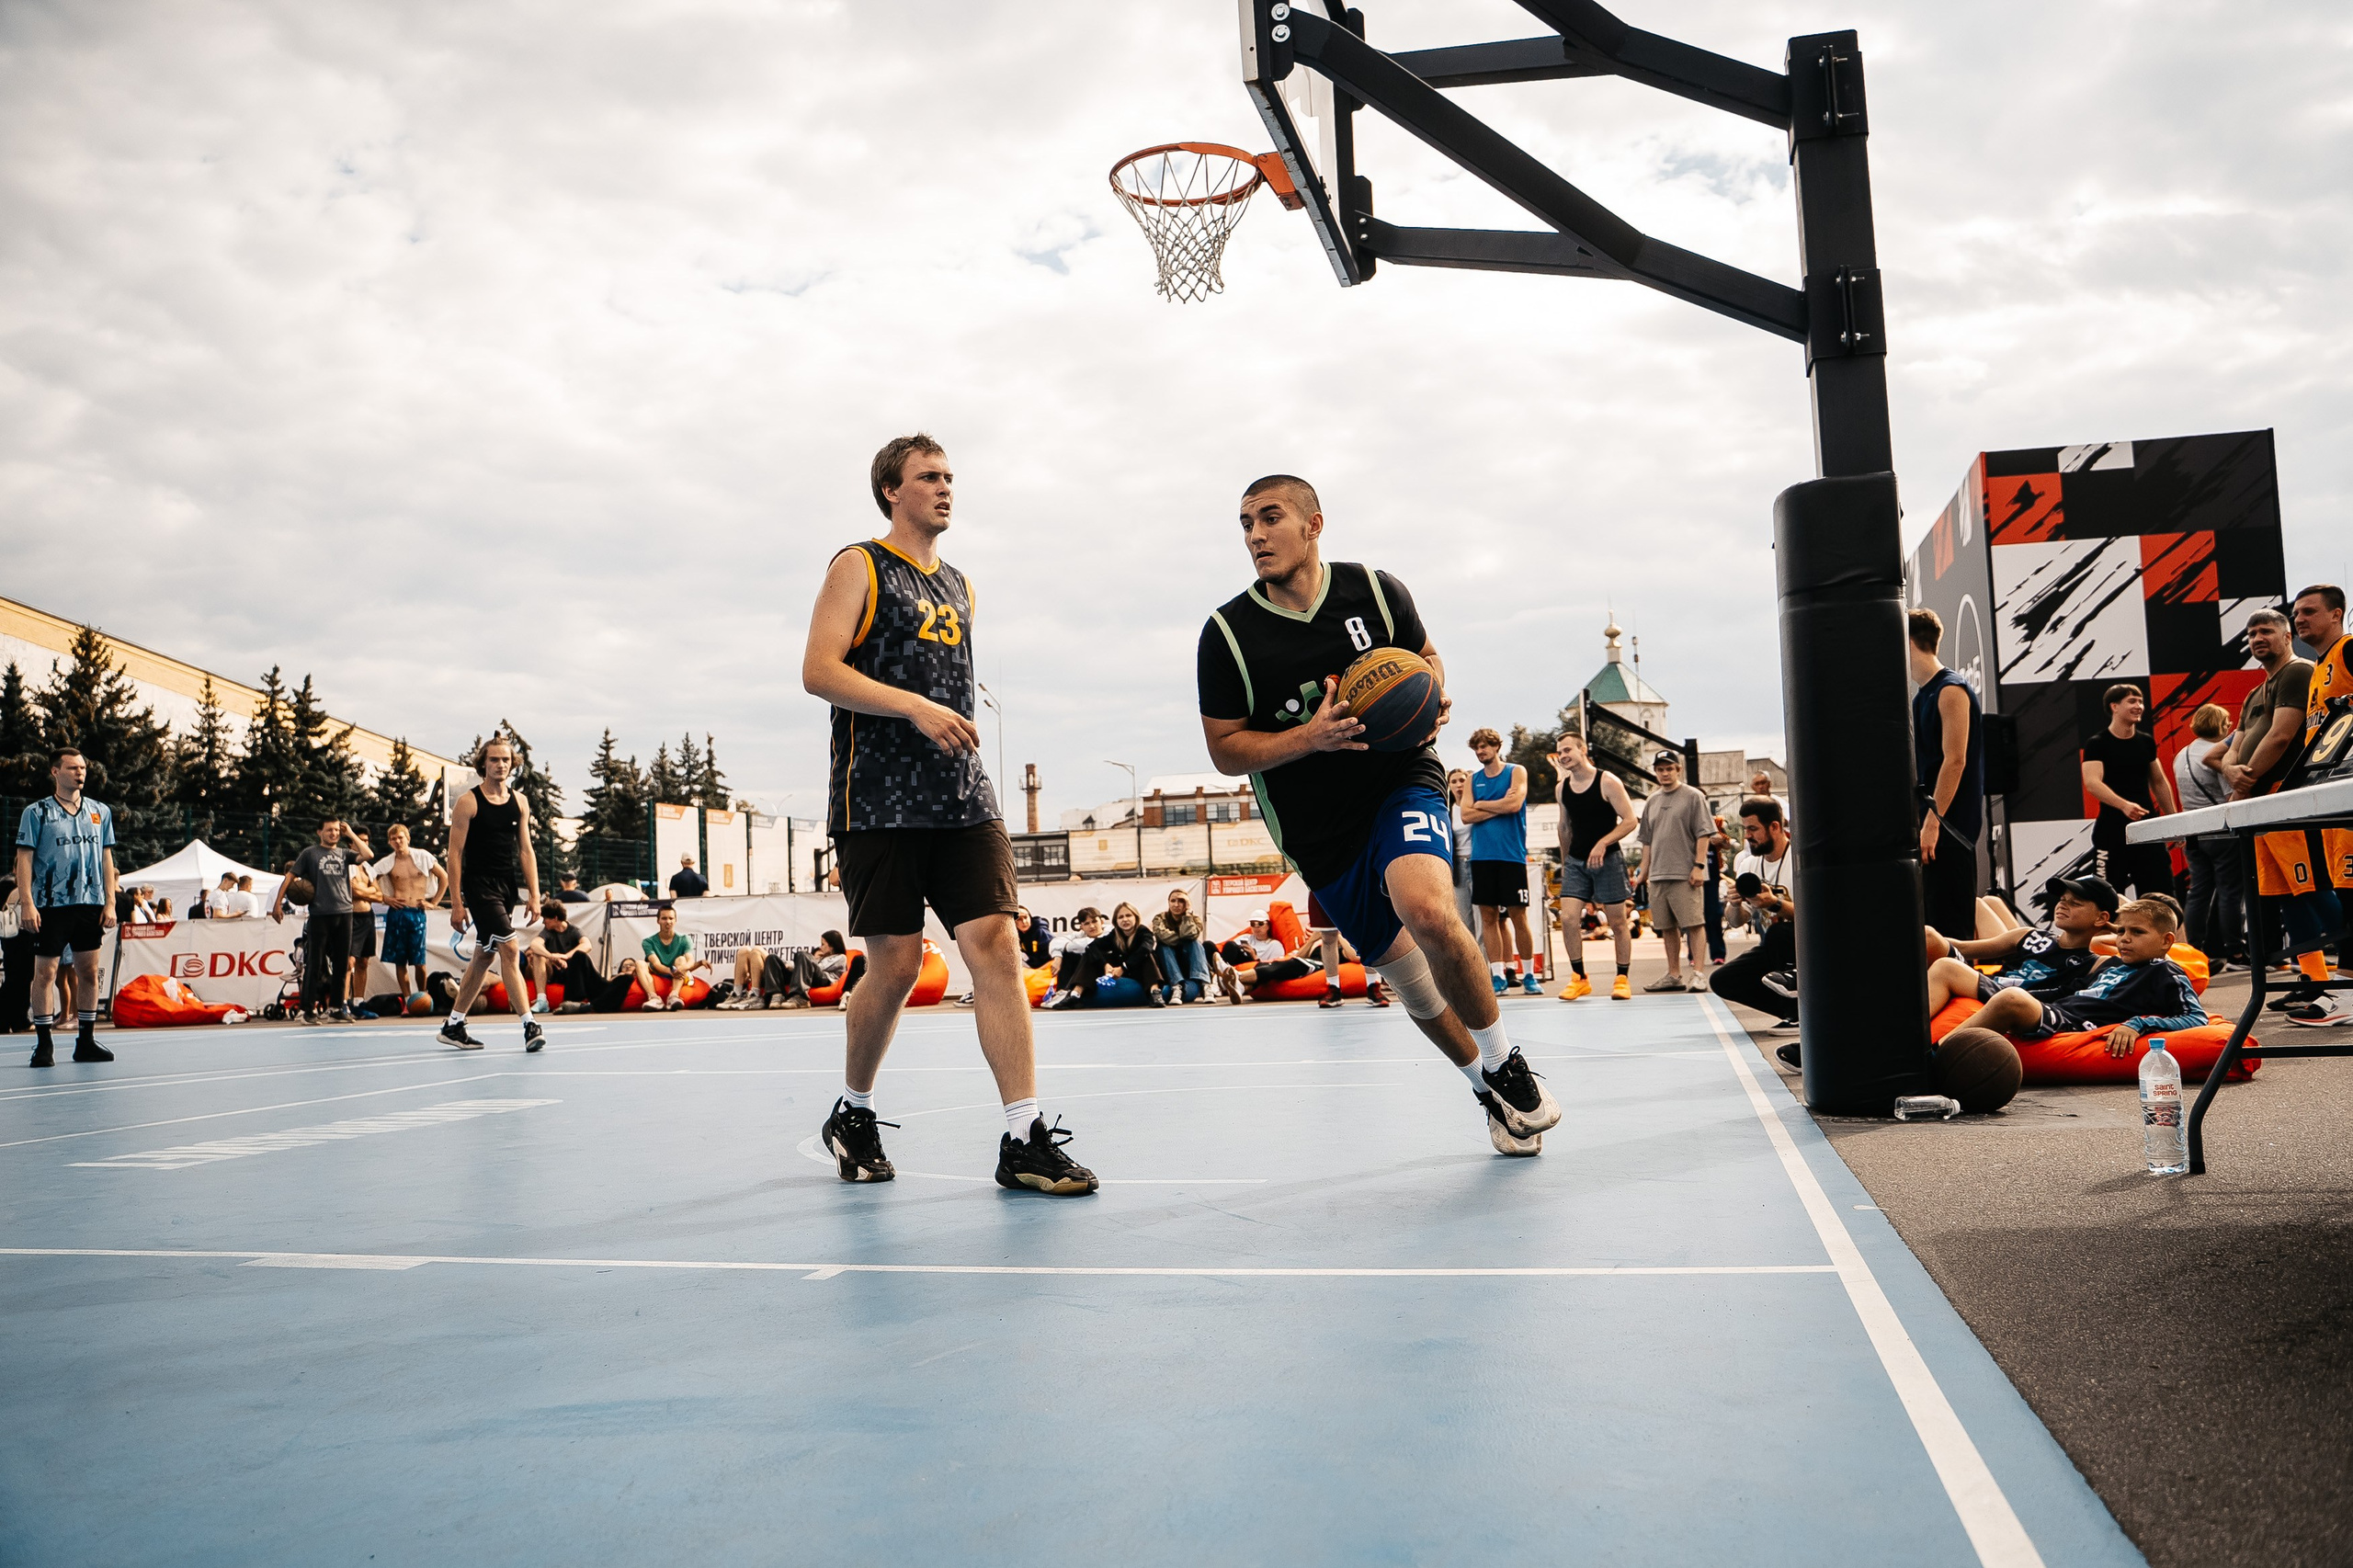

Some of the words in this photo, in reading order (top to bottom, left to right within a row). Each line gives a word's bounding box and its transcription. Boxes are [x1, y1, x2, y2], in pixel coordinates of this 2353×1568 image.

[917, 598, 961, 645] 23
[1345, 617, 1372, 652] 8
[2324, 663, 2334, 686] 3
[2311, 713, 2353, 763] 9
[72, 835, 99, 845] DKC
[1402, 811, 1450, 853] 24
[2293, 861, 2308, 885] 0
[1518, 889, 1529, 903] 13
[704, 928, 752, 948] ТВЕРСКОЙ
[755, 930, 784, 946] ЦЕНТР
[2022, 930, 2053, 954] 23
[209, 949, 285, 978] DKC
[704, 949, 738, 964] УЛИЧН
